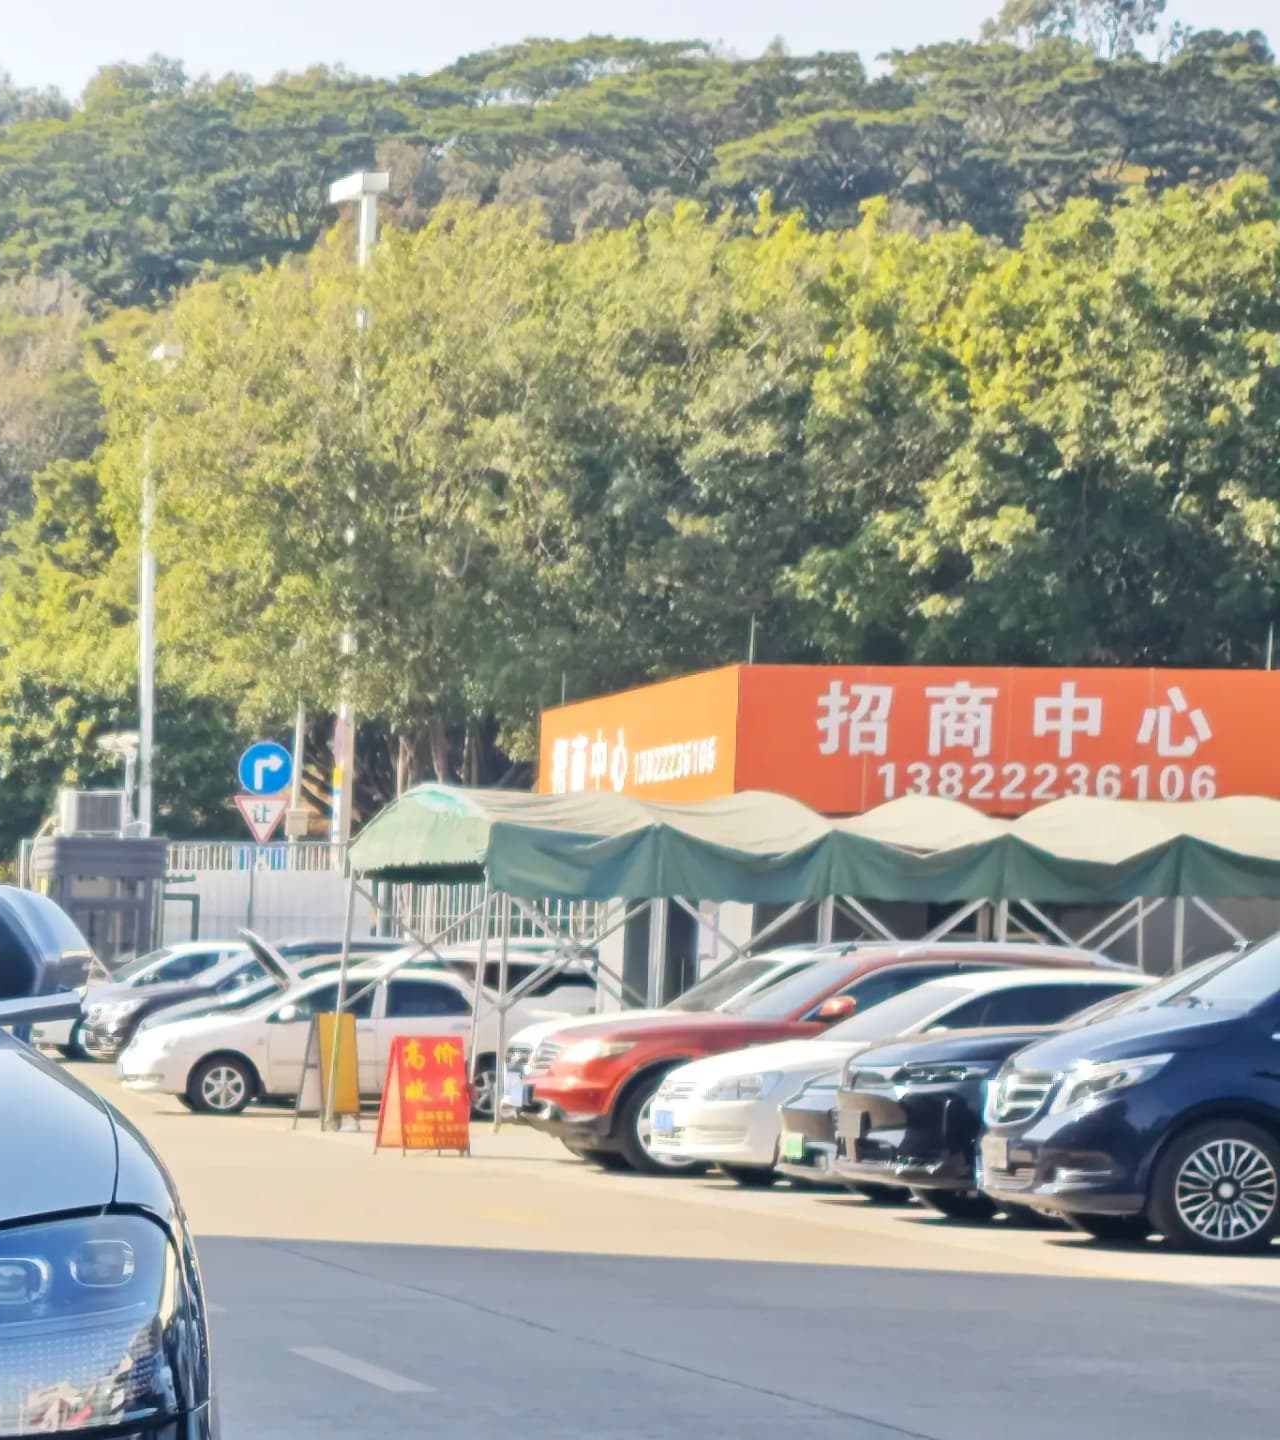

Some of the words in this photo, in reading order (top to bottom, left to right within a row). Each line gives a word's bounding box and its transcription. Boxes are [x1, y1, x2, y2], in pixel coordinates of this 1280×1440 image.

[816, 680, 1213, 758] 招商中心
[877, 762, 1217, 801] 13822236106
[251, 803, 272, 824] 让
